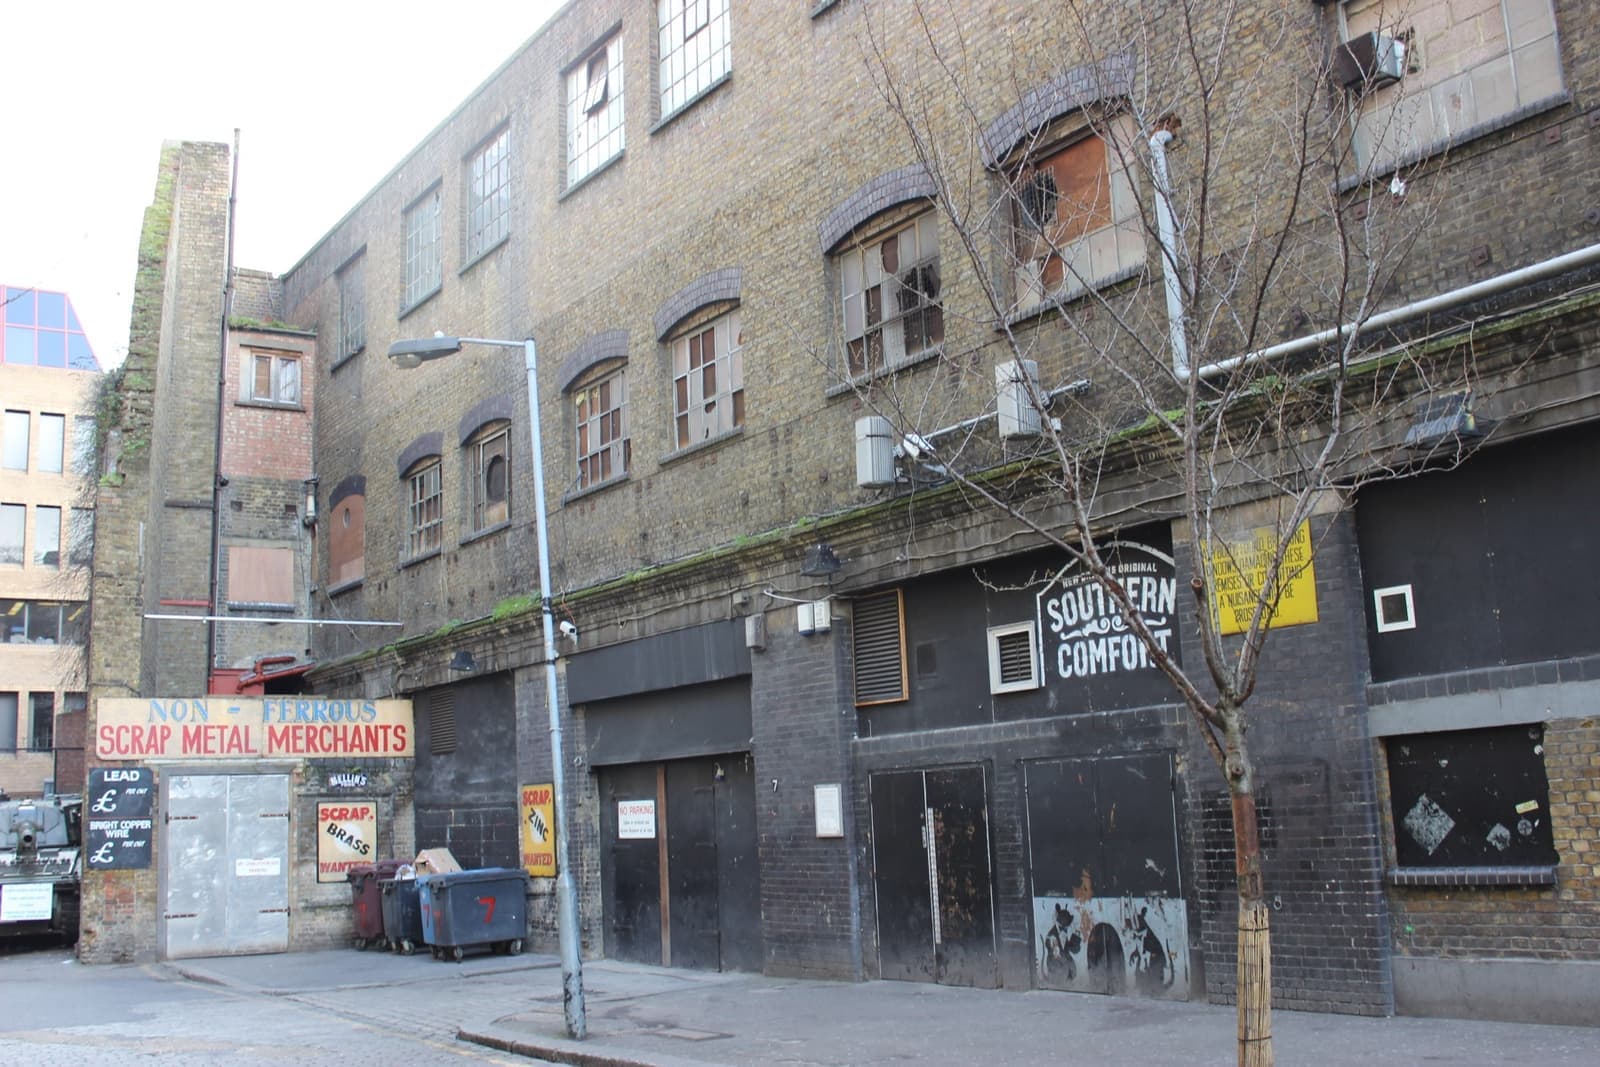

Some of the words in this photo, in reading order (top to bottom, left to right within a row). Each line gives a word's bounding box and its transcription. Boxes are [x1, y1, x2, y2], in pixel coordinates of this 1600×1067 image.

[1280, 546, 1304, 565] HESE
[1118, 562, 1157, 574] ORIGINAL
[148, 699, 209, 723] NON
[263, 699, 377, 723] FERROUS
[99, 725, 172, 755] SCRAP
[182, 725, 258, 755] METAL
[268, 724, 407, 754] MERCHANTS
[103, 770, 140, 782] LEAD
[771, 779, 778, 793] 7
[619, 806, 628, 816] NO
[629, 804, 654, 815] PARKING
[89, 821, 119, 830] BRIGHT
[120, 820, 153, 830] COPPER
[528, 807, 549, 842] ZINC
[105, 829, 130, 839] WIRE
[326, 822, 370, 856] BRASS
[523, 853, 553, 866] WANTED
[320, 861, 373, 874] WANT
[479, 896, 497, 924] 7
